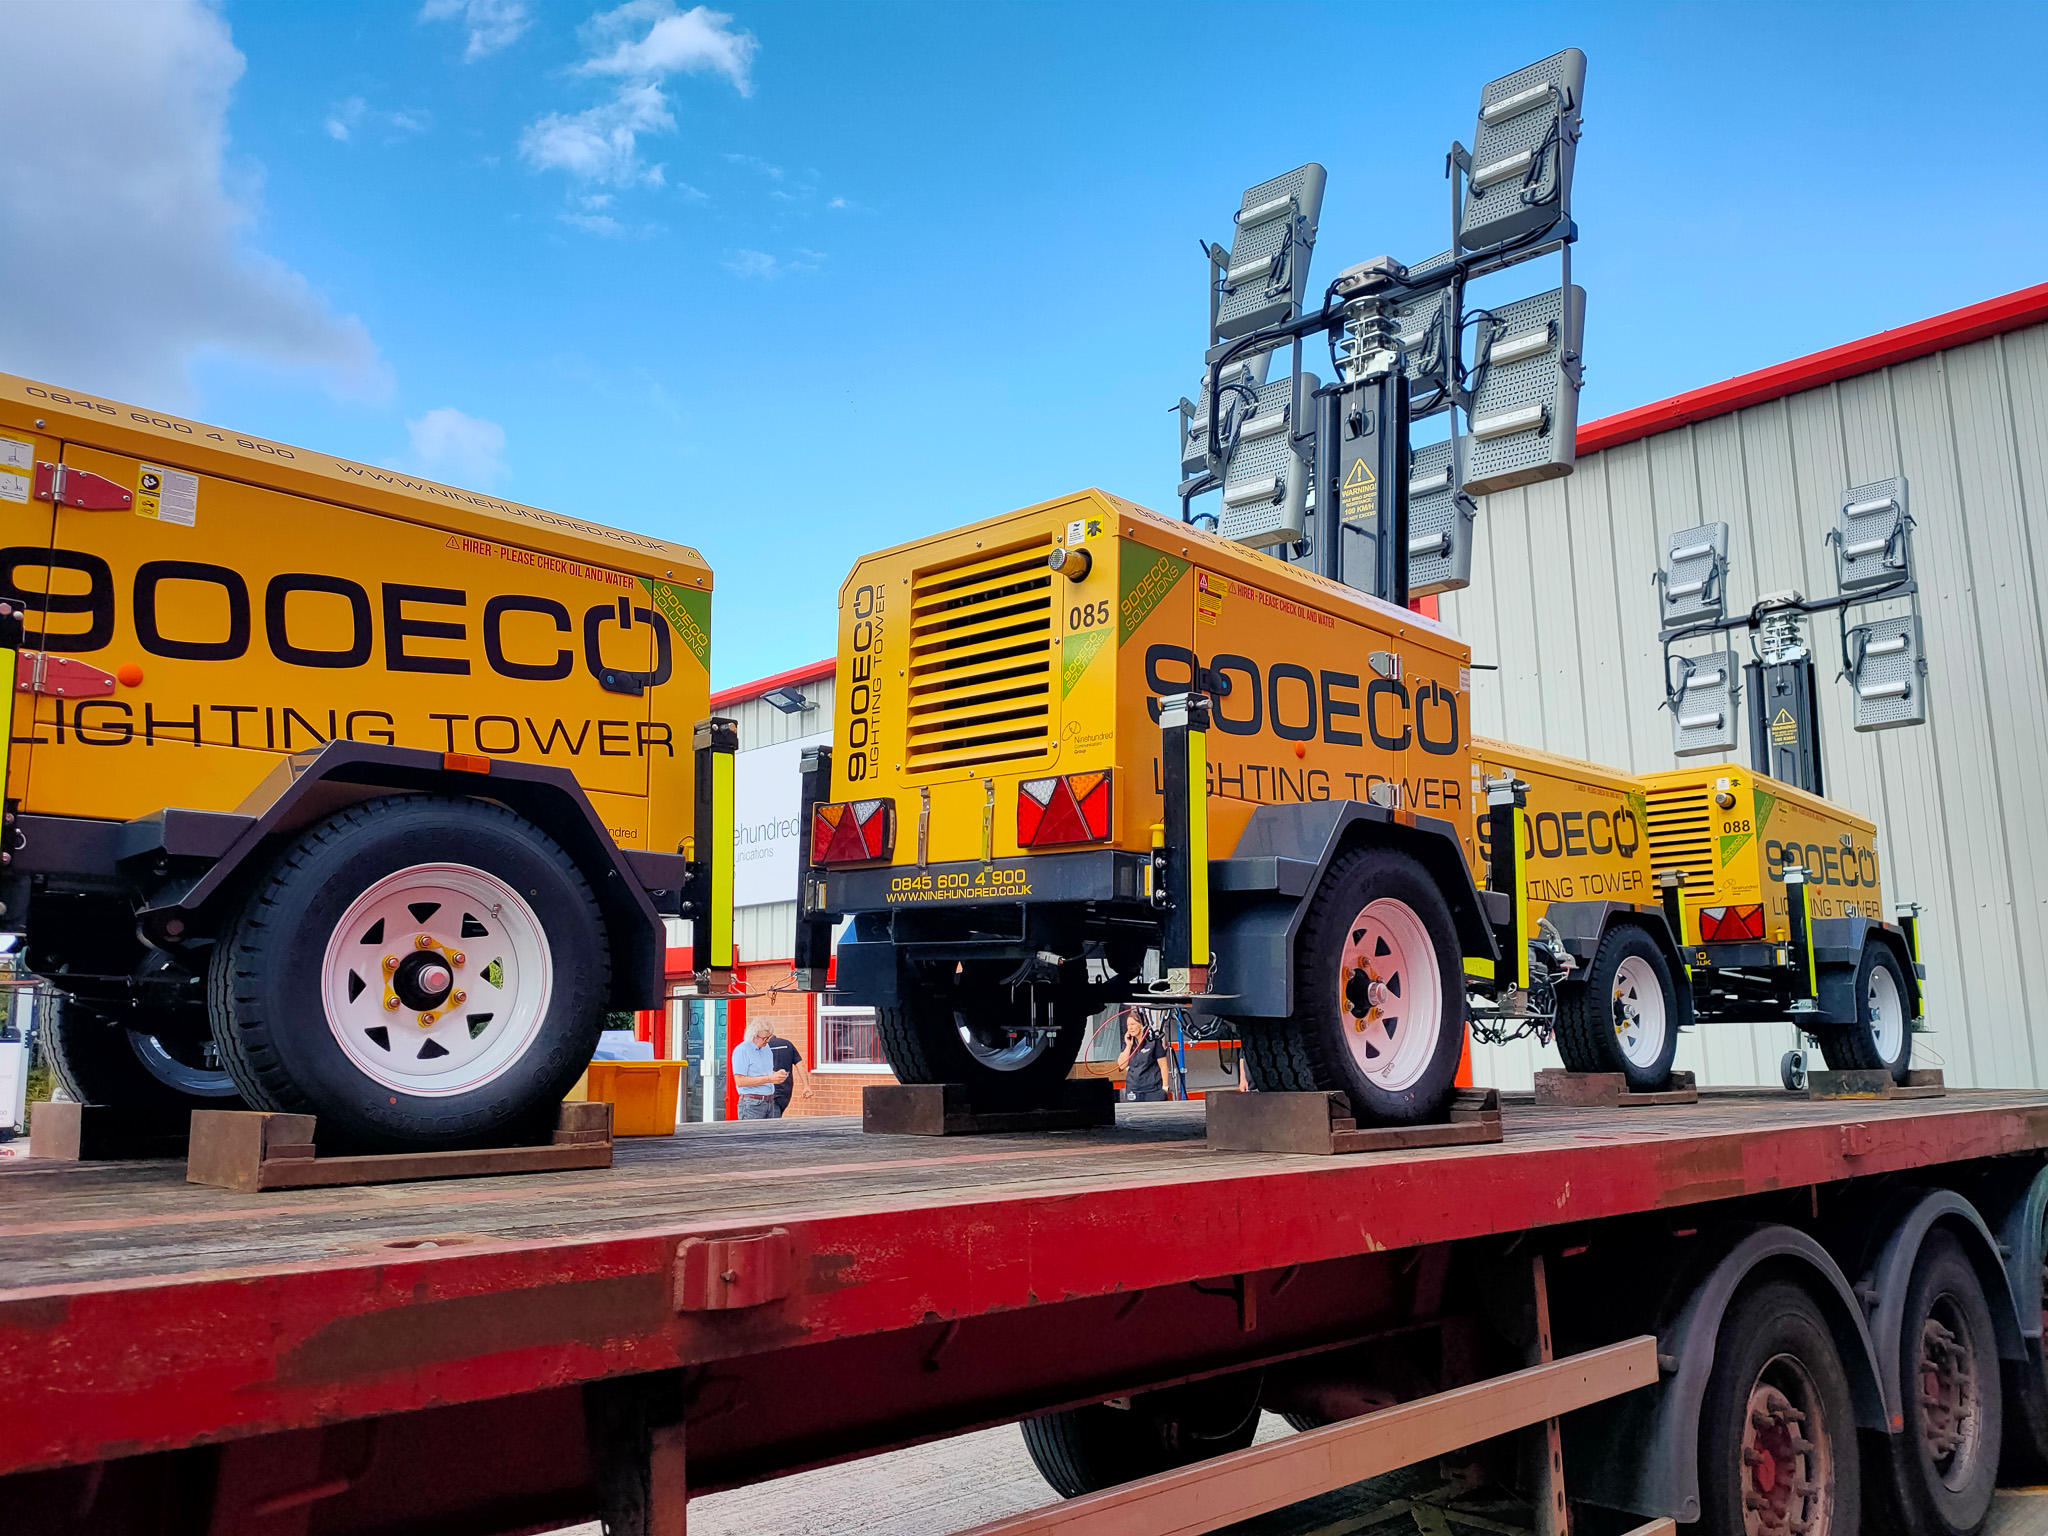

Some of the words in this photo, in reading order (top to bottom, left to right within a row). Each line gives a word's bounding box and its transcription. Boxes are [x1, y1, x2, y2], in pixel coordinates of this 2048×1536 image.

[26, 386, 117, 416] 0845
[131, 412, 193, 434] 600
[205, 432, 225, 442] 4
[236, 438, 296, 460] 900
[336, 462, 668, 553] WWW.NINEHUNDRED.CO.UK
[1341, 483, 1377, 497] WARNING!
[1344, 507, 1356, 515] 100
[462, 538, 492, 557] HIRER
[500, 547, 536, 567] PLEASE
[537, 555, 568, 574] CHECK
[569, 562, 584, 578] OIL
[584, 567, 603, 582] AND
[604, 571, 635, 590] WATER
[1120, 556, 1170, 616] 900ECO
[0, 546, 673, 687] 900ECO
[653, 587, 705, 658] SOLUTIONS
[660, 584, 709, 647] 900ECO
[873, 582, 886, 669] TOWER
[1069, 599, 1110, 631] 085
[1125, 565, 1179, 631] SOLUTIONS
[1237, 584, 1255, 601] HIRER
[1258, 591, 1279, 610] PLEASE
[1279, 601, 1297, 616] CHECK
[1297, 607, 1306, 620] OIL
[1306, 610, 1317, 623] AND
[1317, 613, 1336, 630] WATER
[847, 584, 874, 782] 900ECO
[1064, 632, 1097, 682] 900ECO
[1066, 633, 1105, 690] SOLUTIONS
[1145, 643, 1459, 756] 900ECO
[428, 713, 674, 758] TOWER
[869, 677, 883, 780] LIGHTING
[1722, 819, 1751, 834] 088
[885, 884, 1033, 903] WWW.NINEHUNDRED.CO.UK
[891, 875, 932, 892] 0845
[937, 873, 969, 889] 600
[974, 871, 986, 886] 4
[991, 868, 1026, 885] 900
[1579, 869, 1644, 896] TOWER
